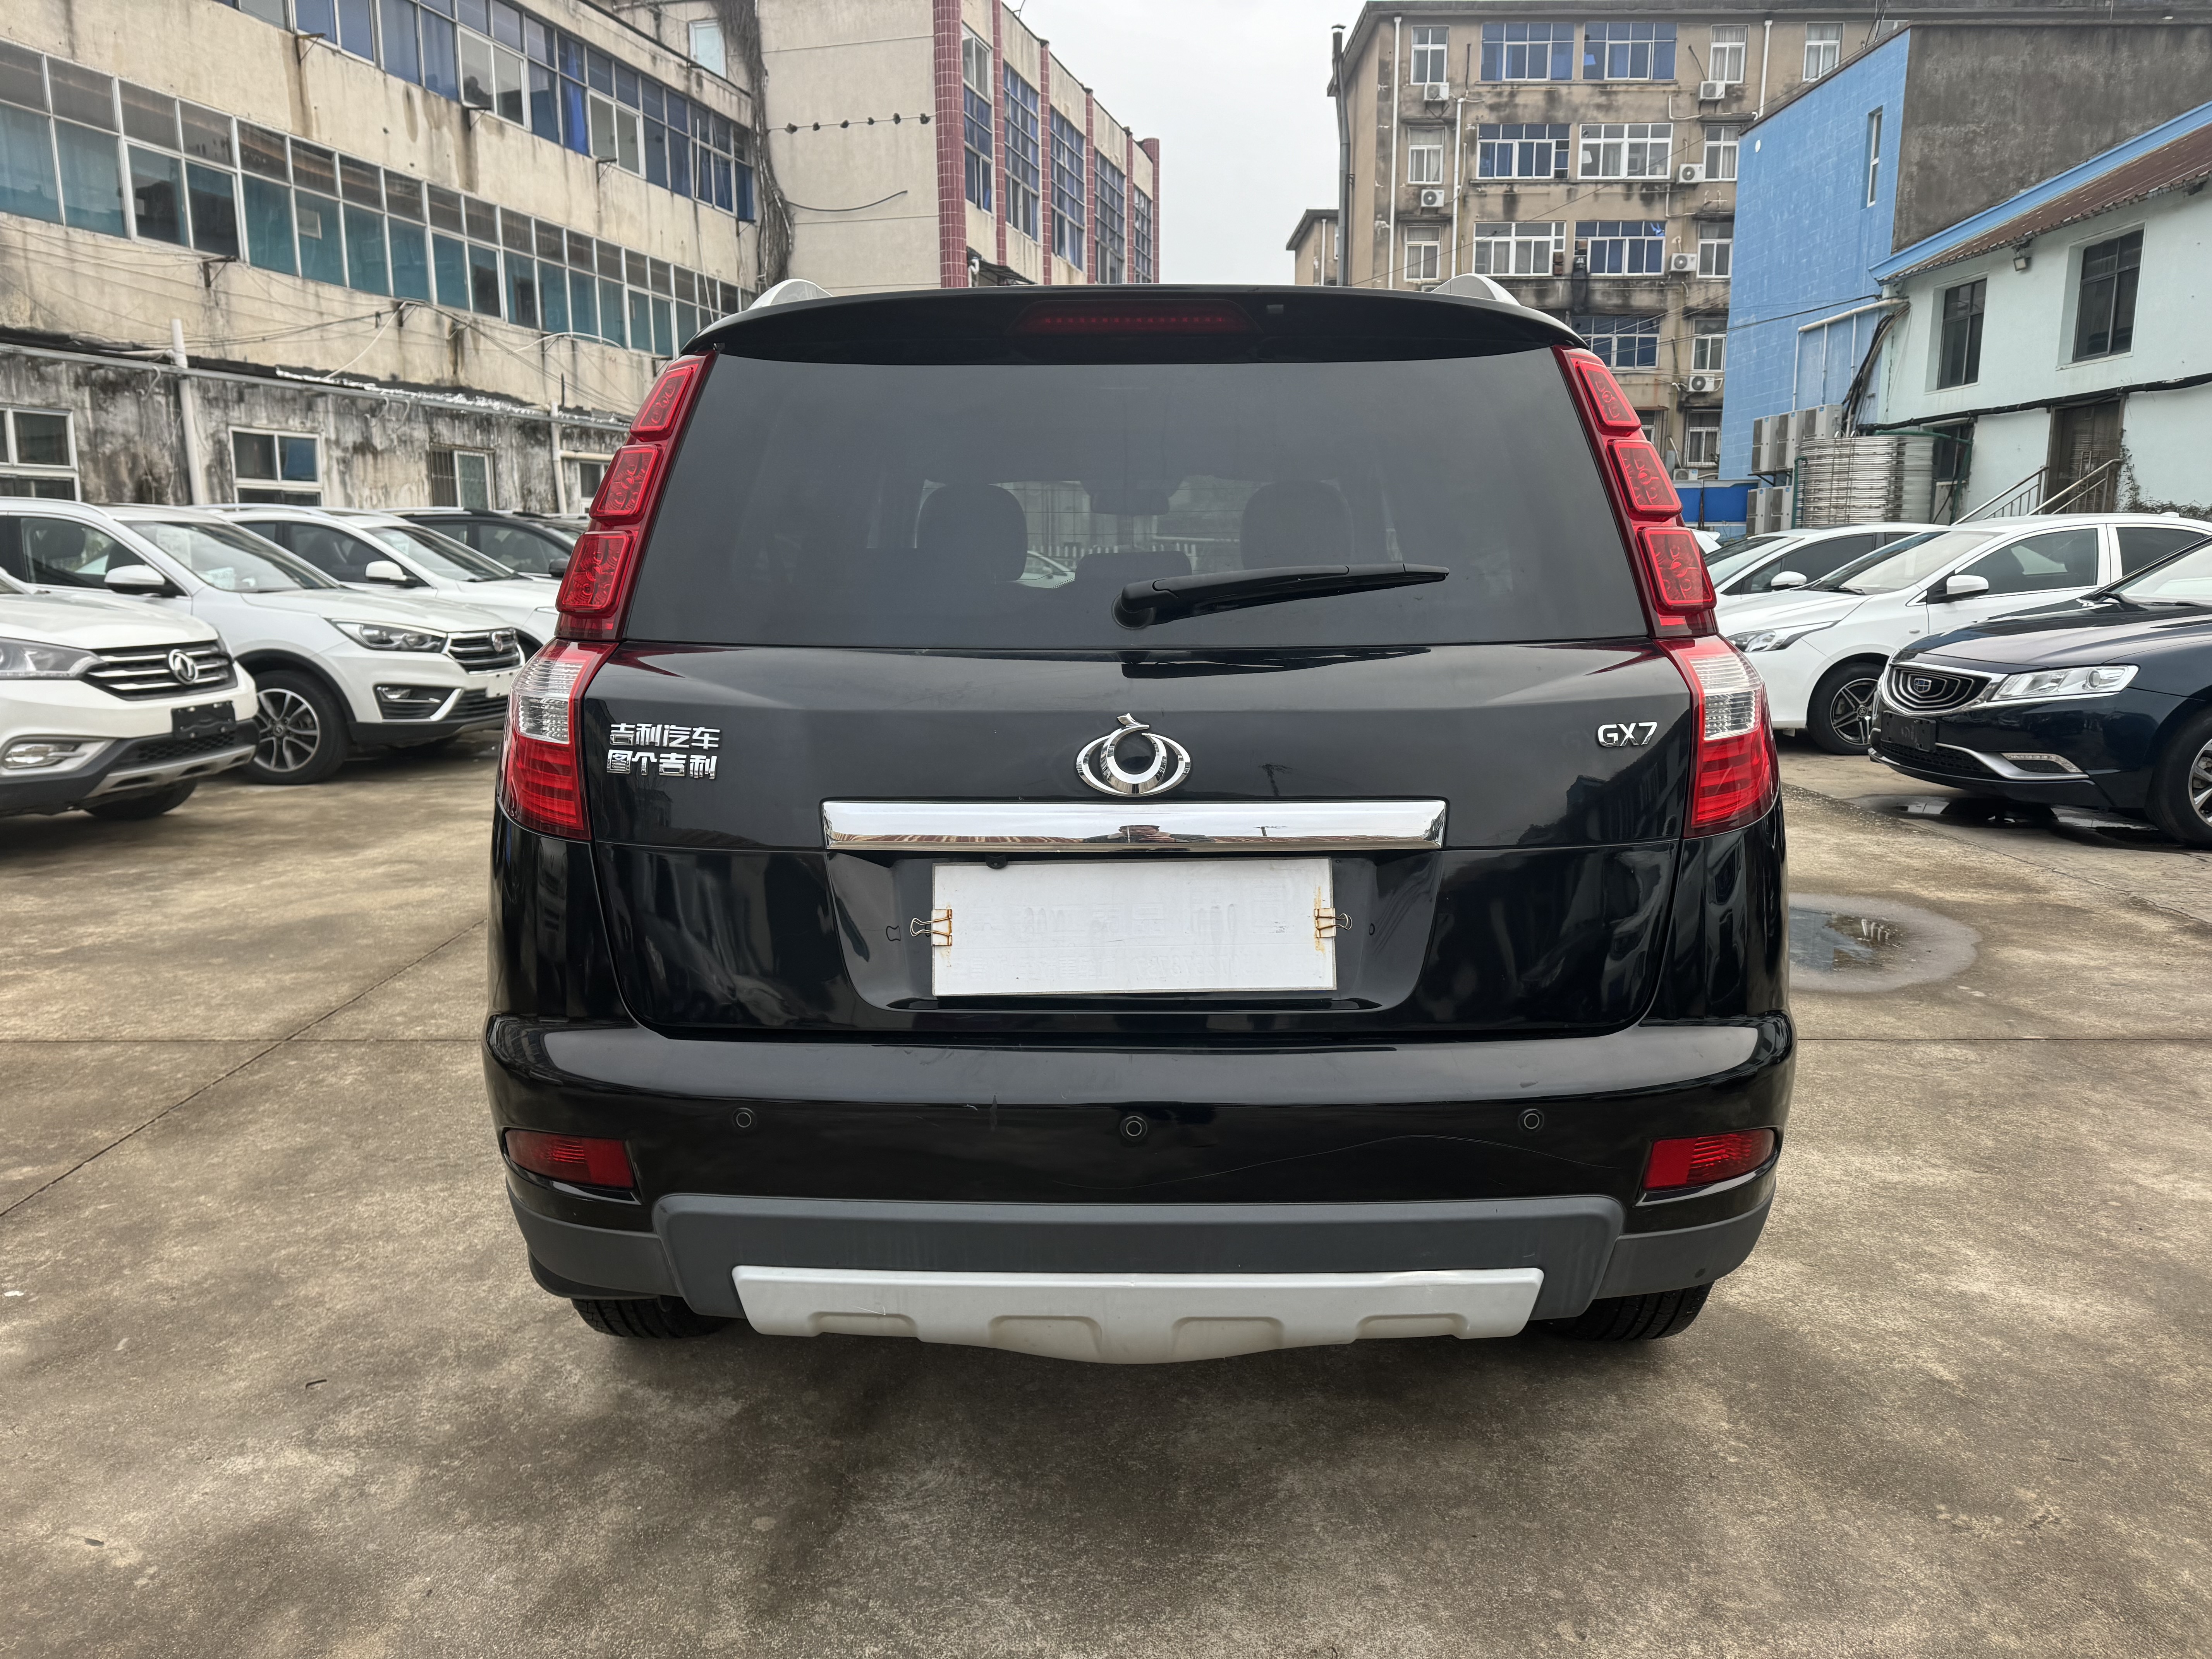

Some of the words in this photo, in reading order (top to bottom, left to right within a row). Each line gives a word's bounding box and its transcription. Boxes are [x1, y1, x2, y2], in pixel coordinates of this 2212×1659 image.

[610, 723, 721, 750] 吉利汽车
[1597, 722, 1657, 747] GX7
